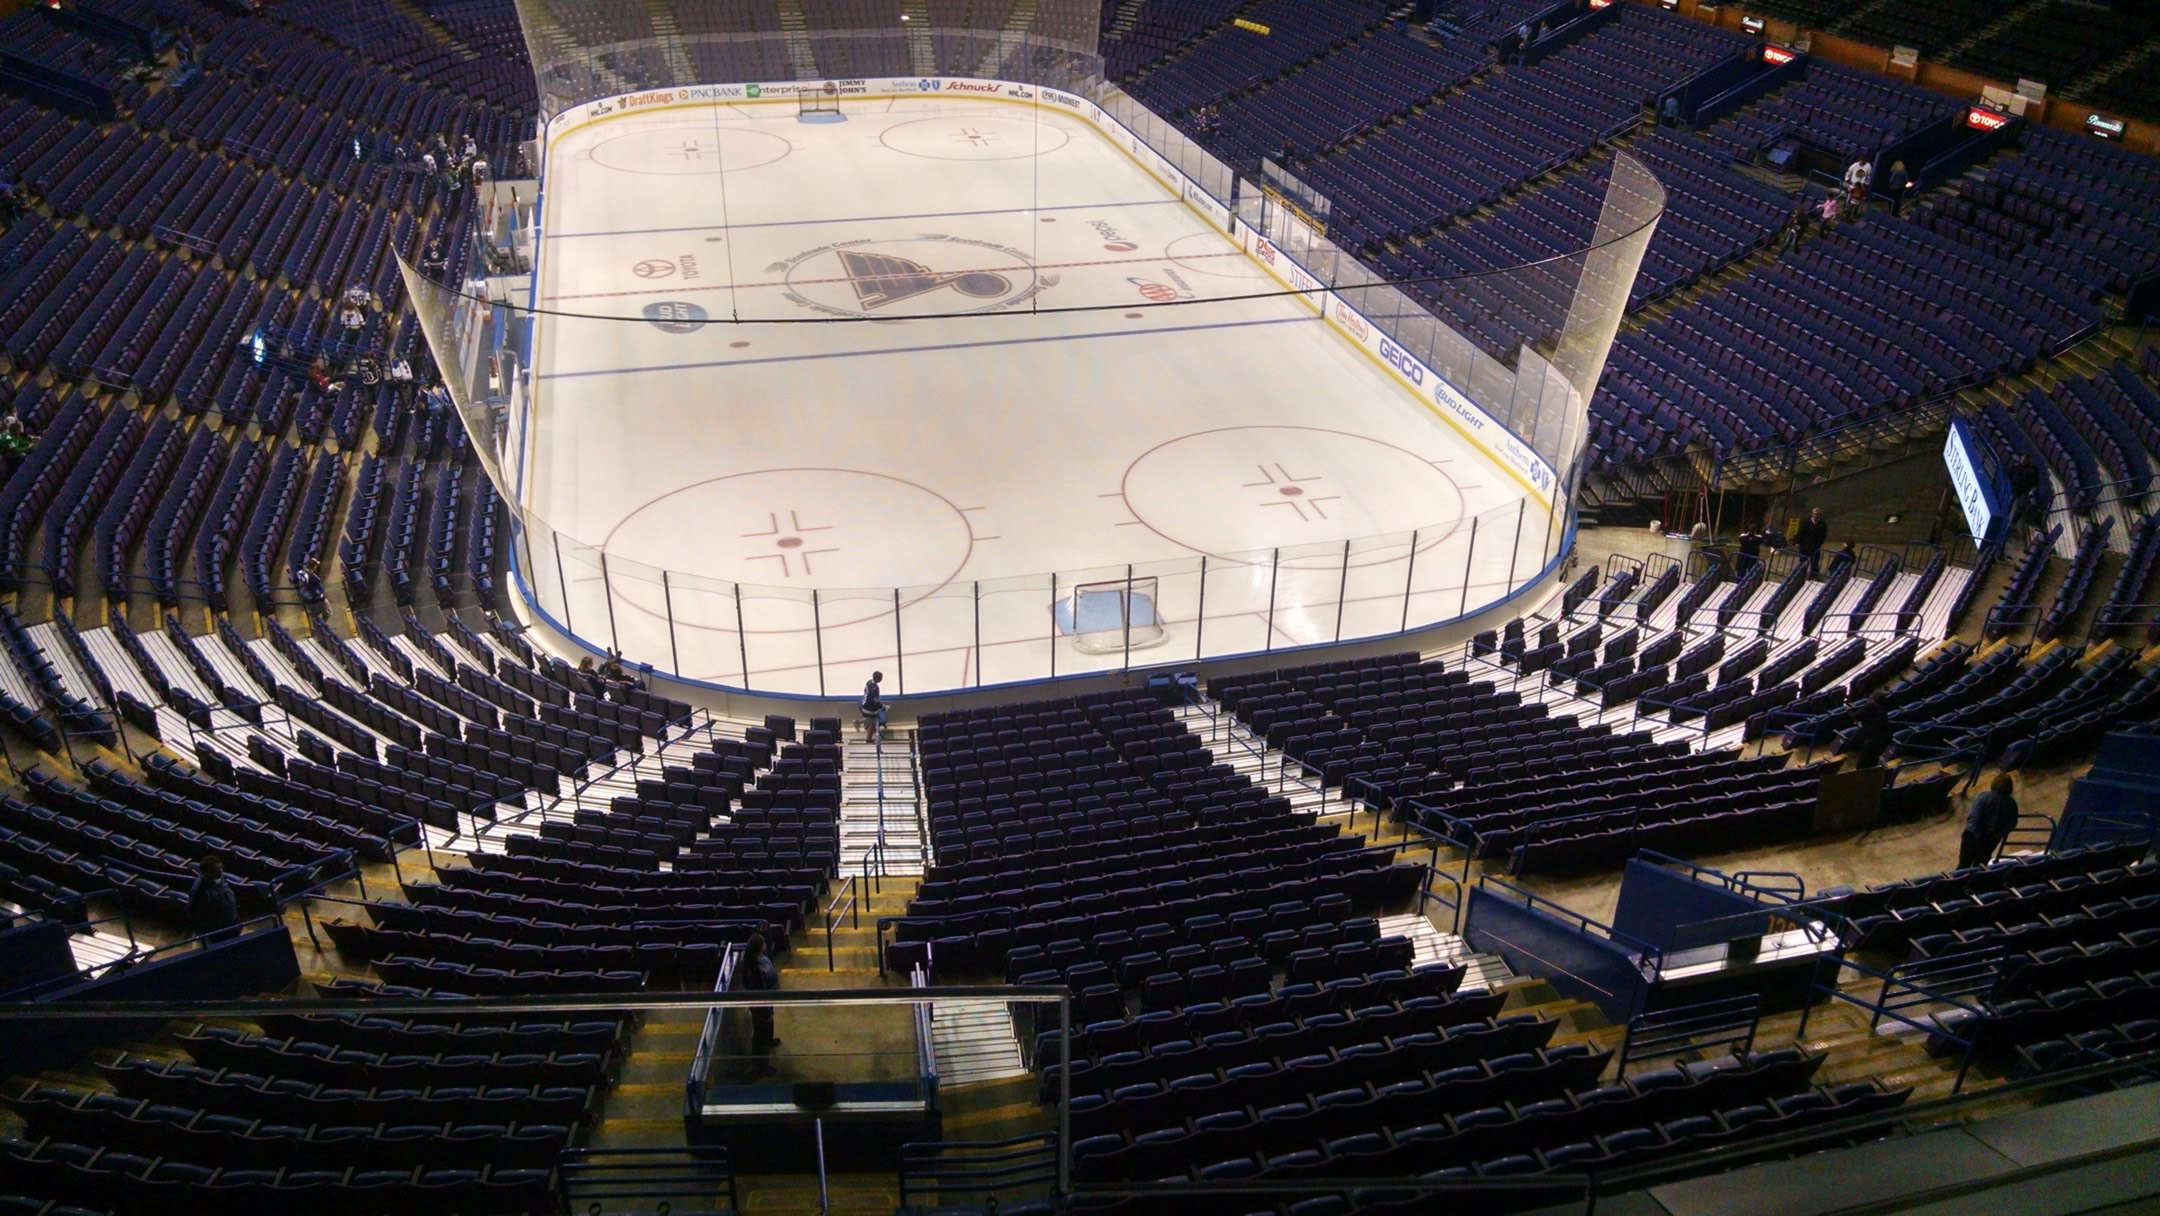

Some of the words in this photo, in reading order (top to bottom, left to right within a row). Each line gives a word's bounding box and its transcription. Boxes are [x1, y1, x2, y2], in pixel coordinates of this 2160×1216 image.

[839, 80, 866, 88] JIMMY
[839, 87, 867, 95] JOHN'S
[945, 81, 1003, 92] Schnucks
[629, 91, 674, 107] DraftKings
[1008, 90, 1033, 99] NHL.COM
[590, 105, 613, 117] NHL.COM
[679, 253, 701, 280] TOYOTA
[1380, 337, 1424, 387] GEICO
[1439, 388, 1457, 409] BUD
[1456, 403, 1485, 430] LIGHT
[1946, 430, 1972, 503] STERLING
[1968, 489, 1985, 538] BANK
